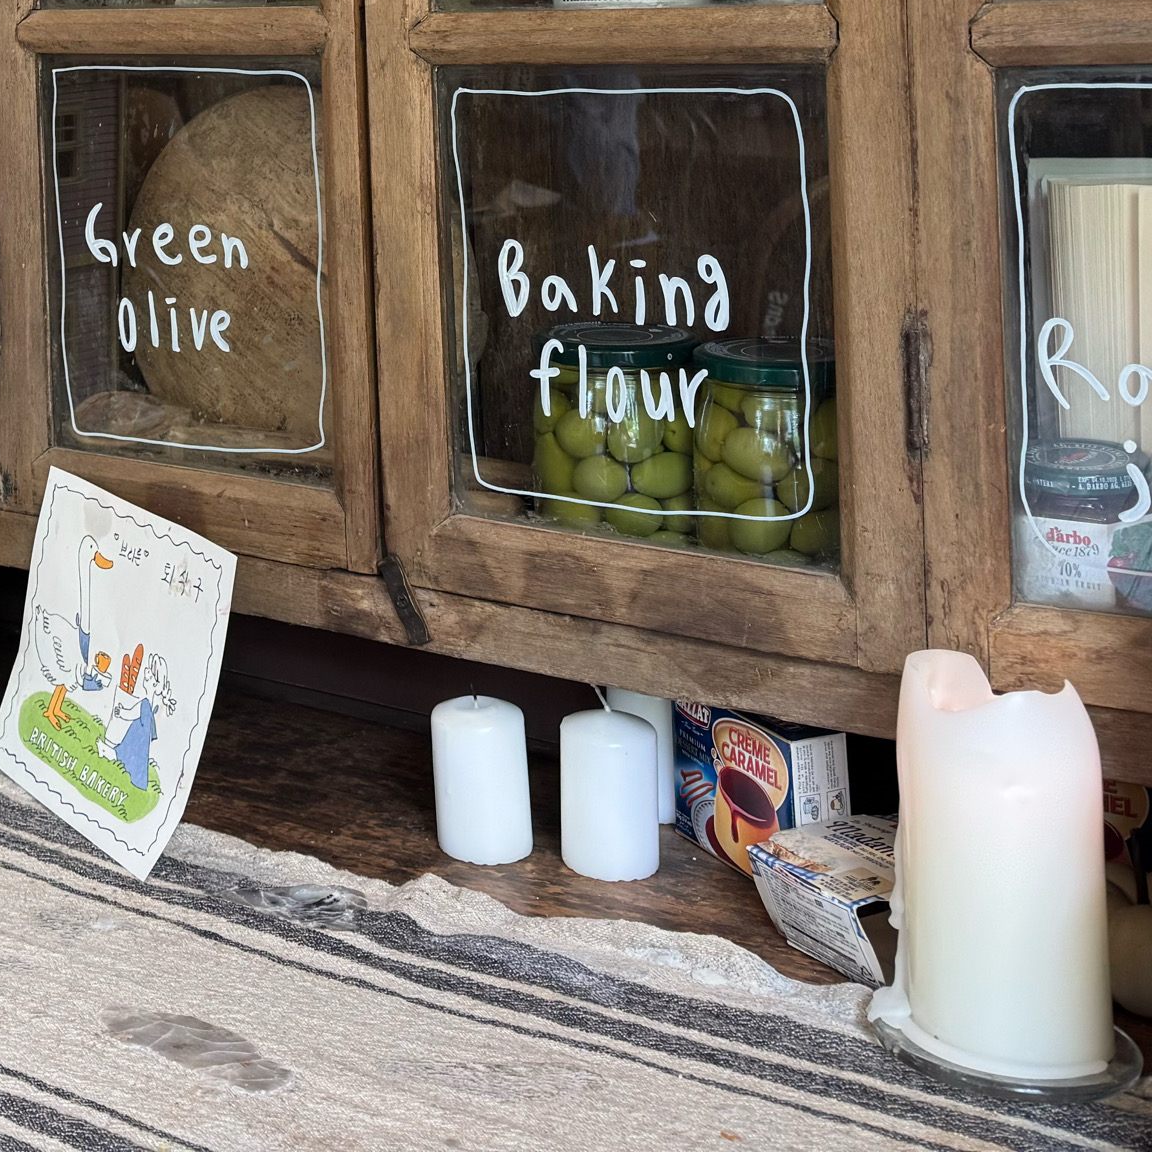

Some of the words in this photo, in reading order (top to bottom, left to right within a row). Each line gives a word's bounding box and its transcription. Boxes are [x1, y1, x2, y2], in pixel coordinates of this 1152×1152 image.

[85, 202, 248, 269] Green
[498, 239, 729, 331] Baking
[529, 339, 708, 428] flour
[29, 726, 78, 771] BRITISH
[79, 764, 128, 807] BAKERY
[722, 741, 781, 790] CARAMEL
